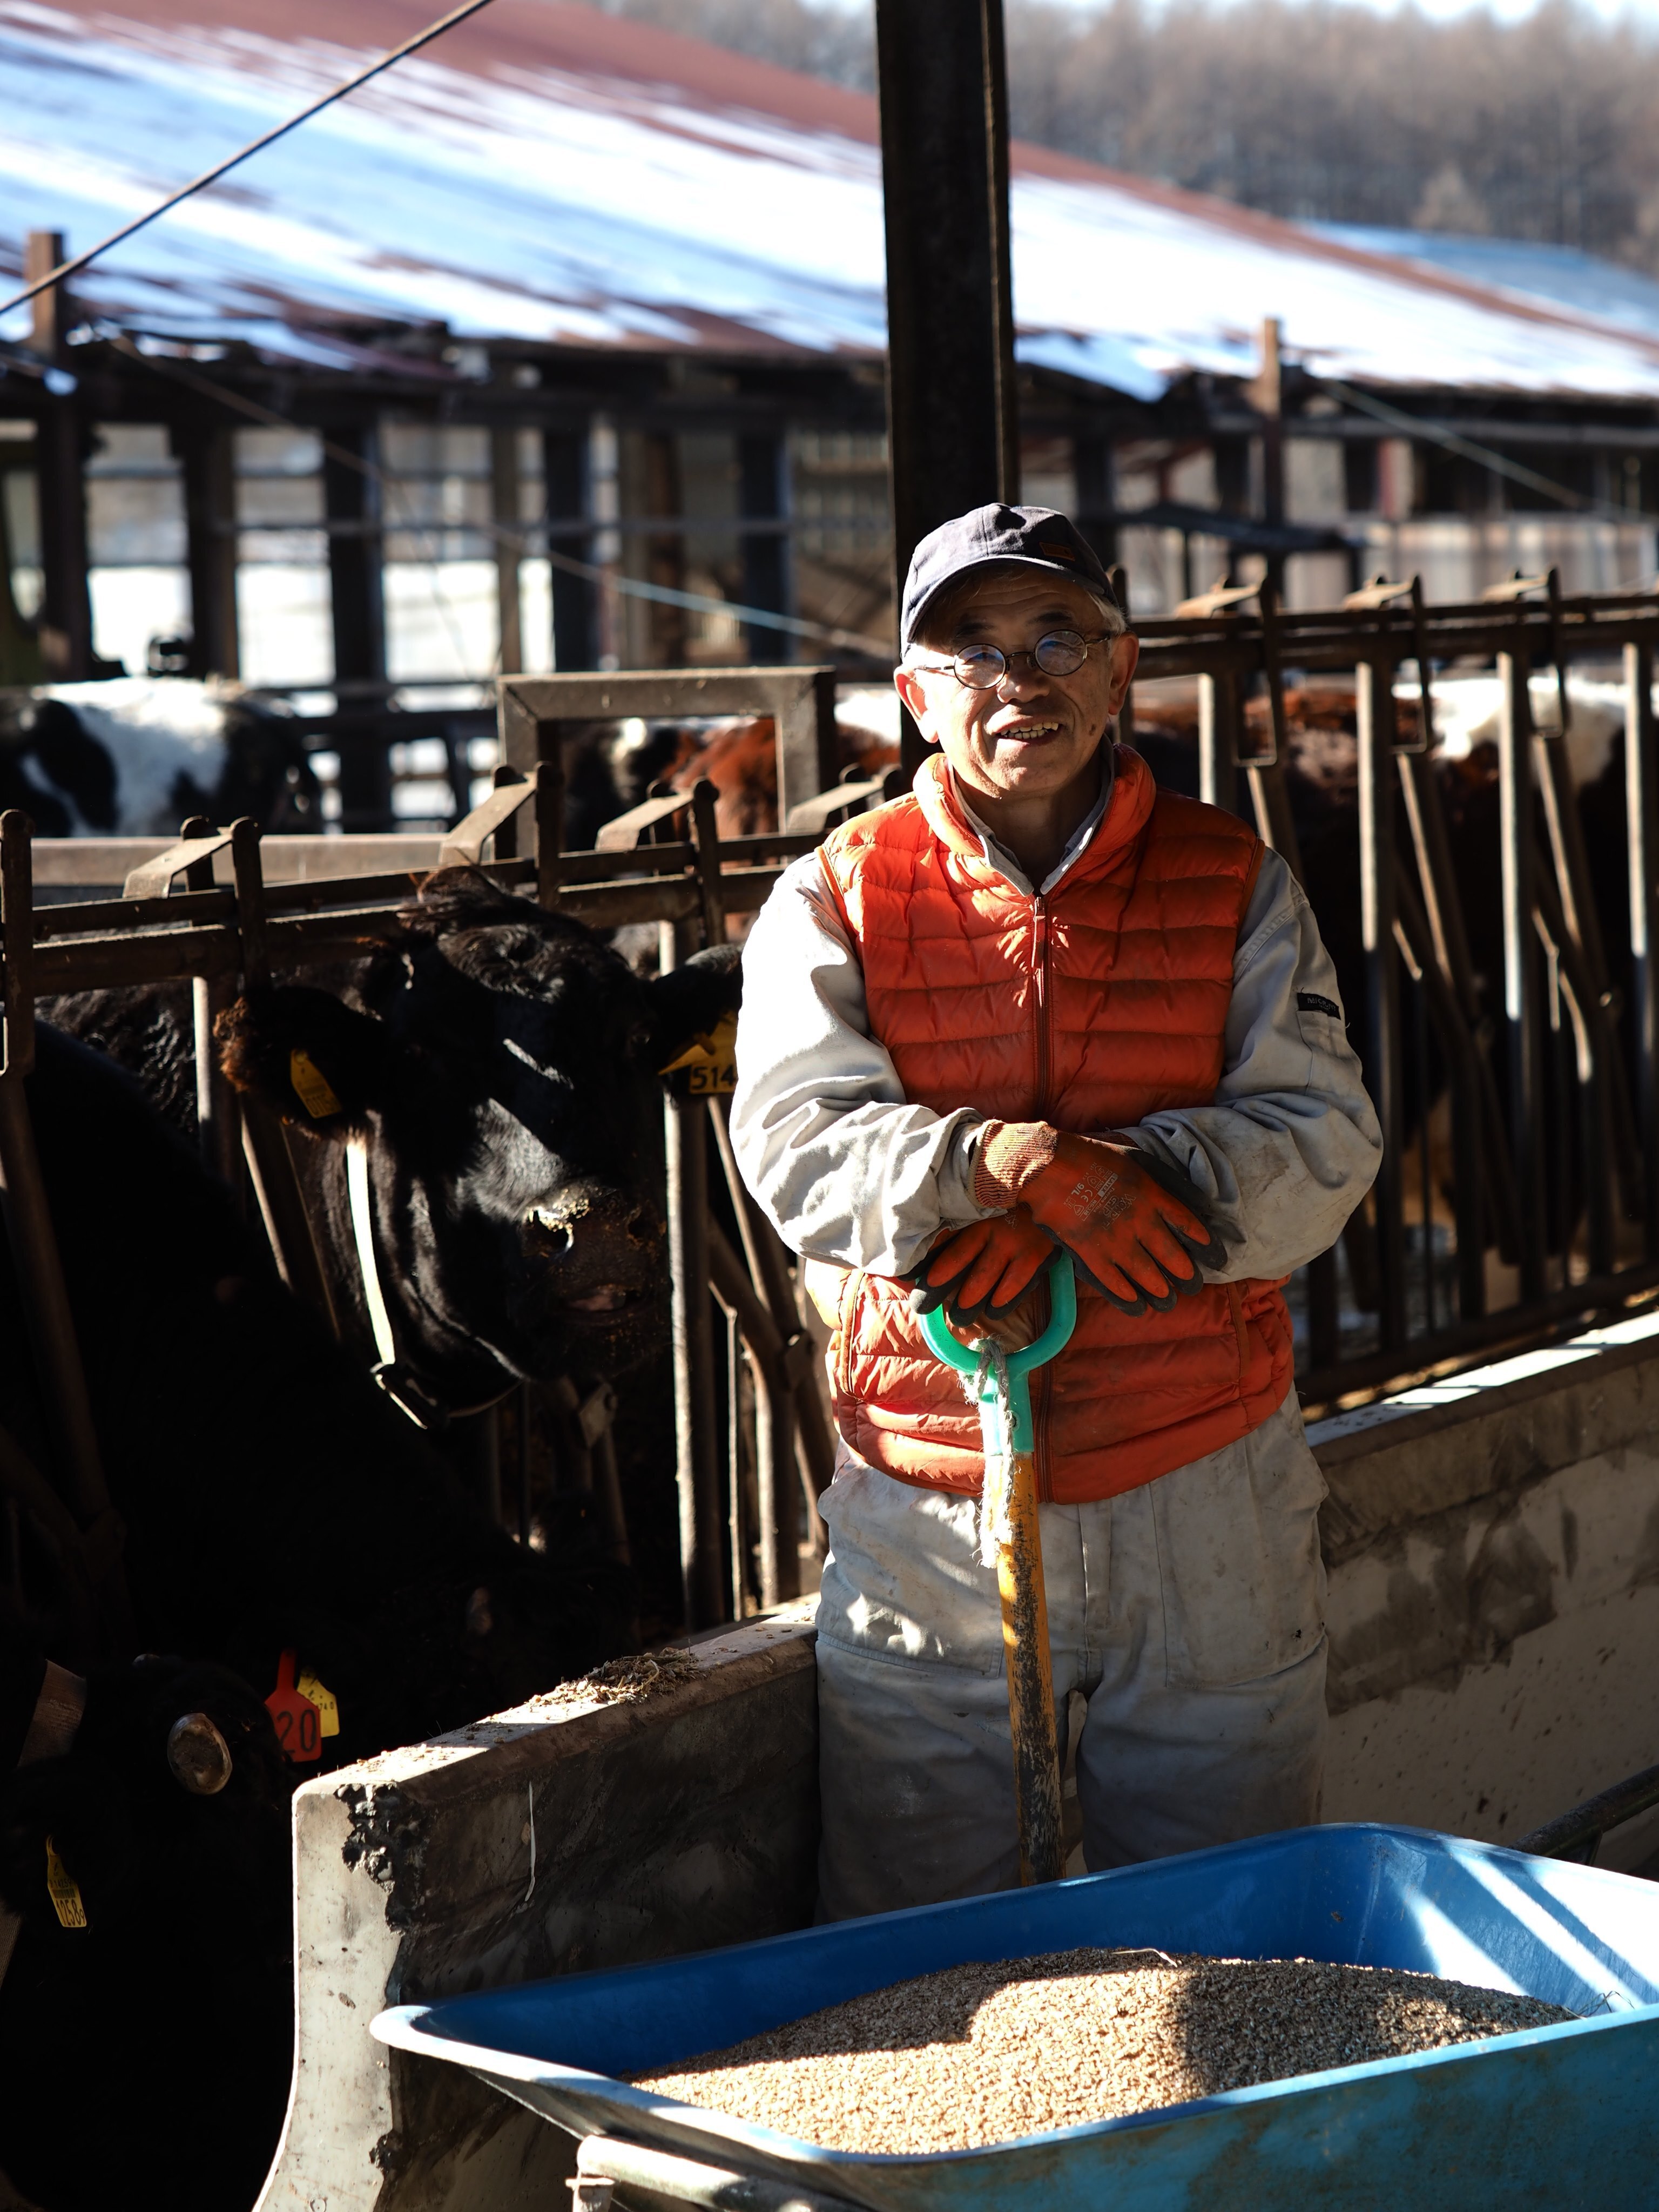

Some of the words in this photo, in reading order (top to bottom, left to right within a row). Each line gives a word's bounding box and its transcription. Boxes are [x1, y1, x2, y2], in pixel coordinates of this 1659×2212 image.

[693, 1066, 735, 1089] 514
[1070, 1182, 1085, 1197] 9/L
[1101, 1177, 1115, 1192] LATEX
[1101, 1186, 1115, 1203] Thermo
[277, 1710, 316, 1753] 20
